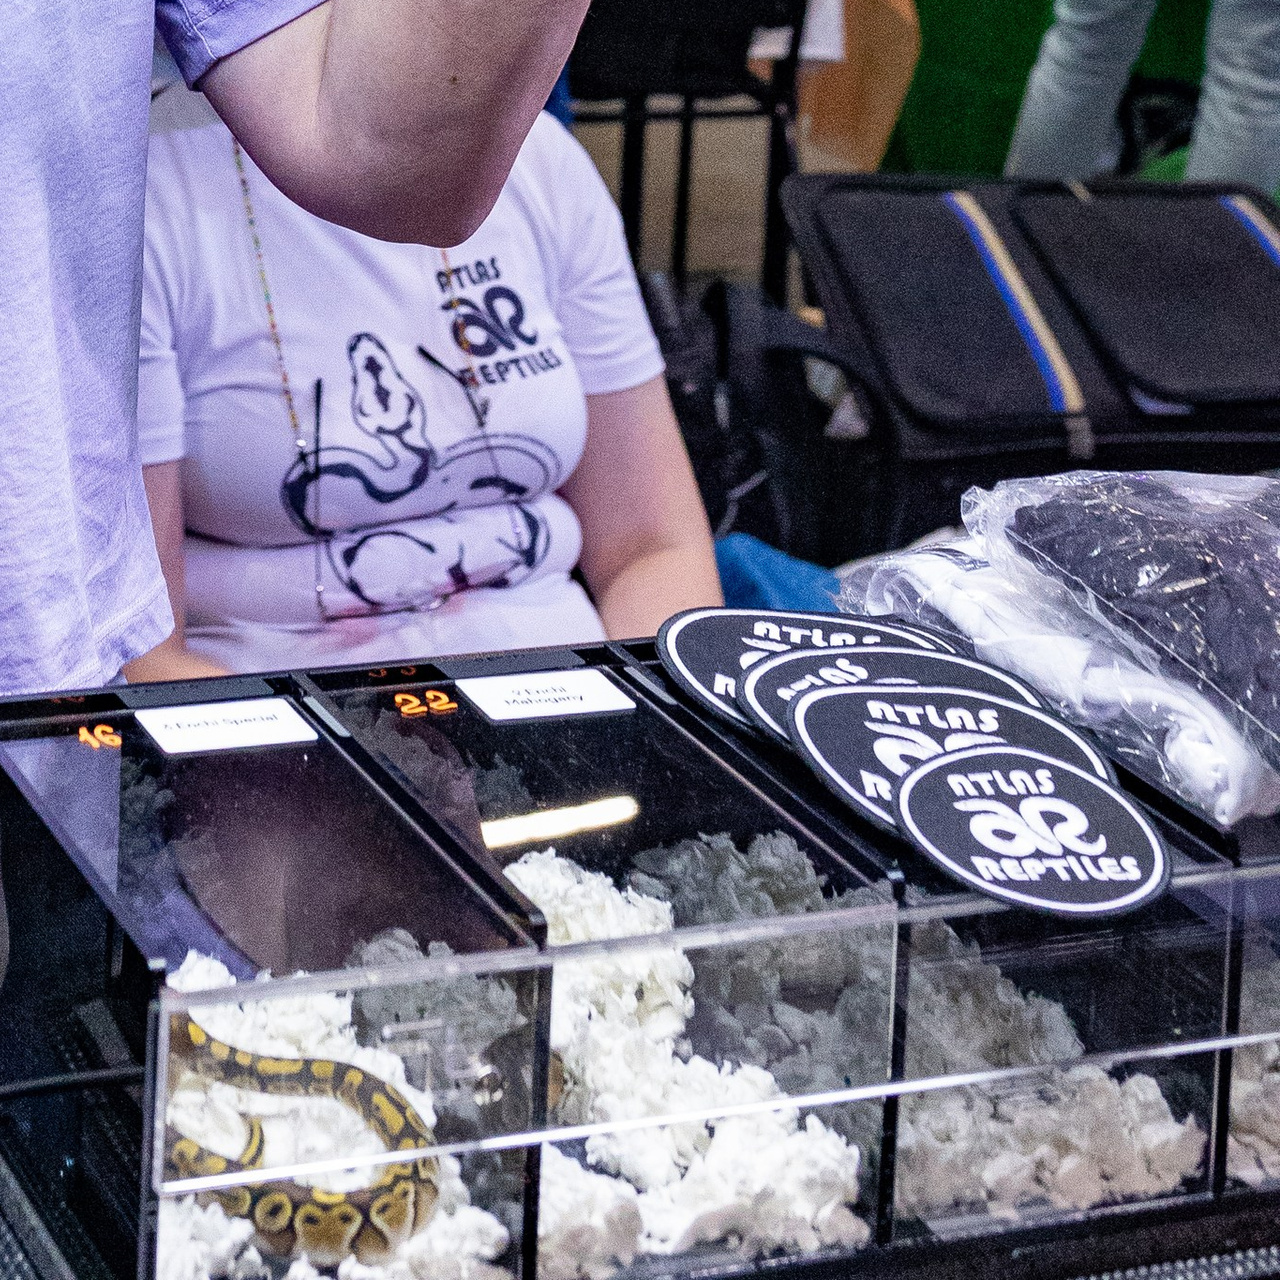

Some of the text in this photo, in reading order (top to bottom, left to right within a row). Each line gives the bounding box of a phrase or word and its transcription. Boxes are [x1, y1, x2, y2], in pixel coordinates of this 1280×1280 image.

[436, 257, 500, 292] ATLAS
[394, 689, 458, 714] 22
[504, 692, 585, 706] Mahogany
[866, 700, 999, 732] ATLAS
[78, 724, 122, 749] 16
[947, 769, 1055, 796] ATLAS
[970, 855, 1141, 881] REPTILES
